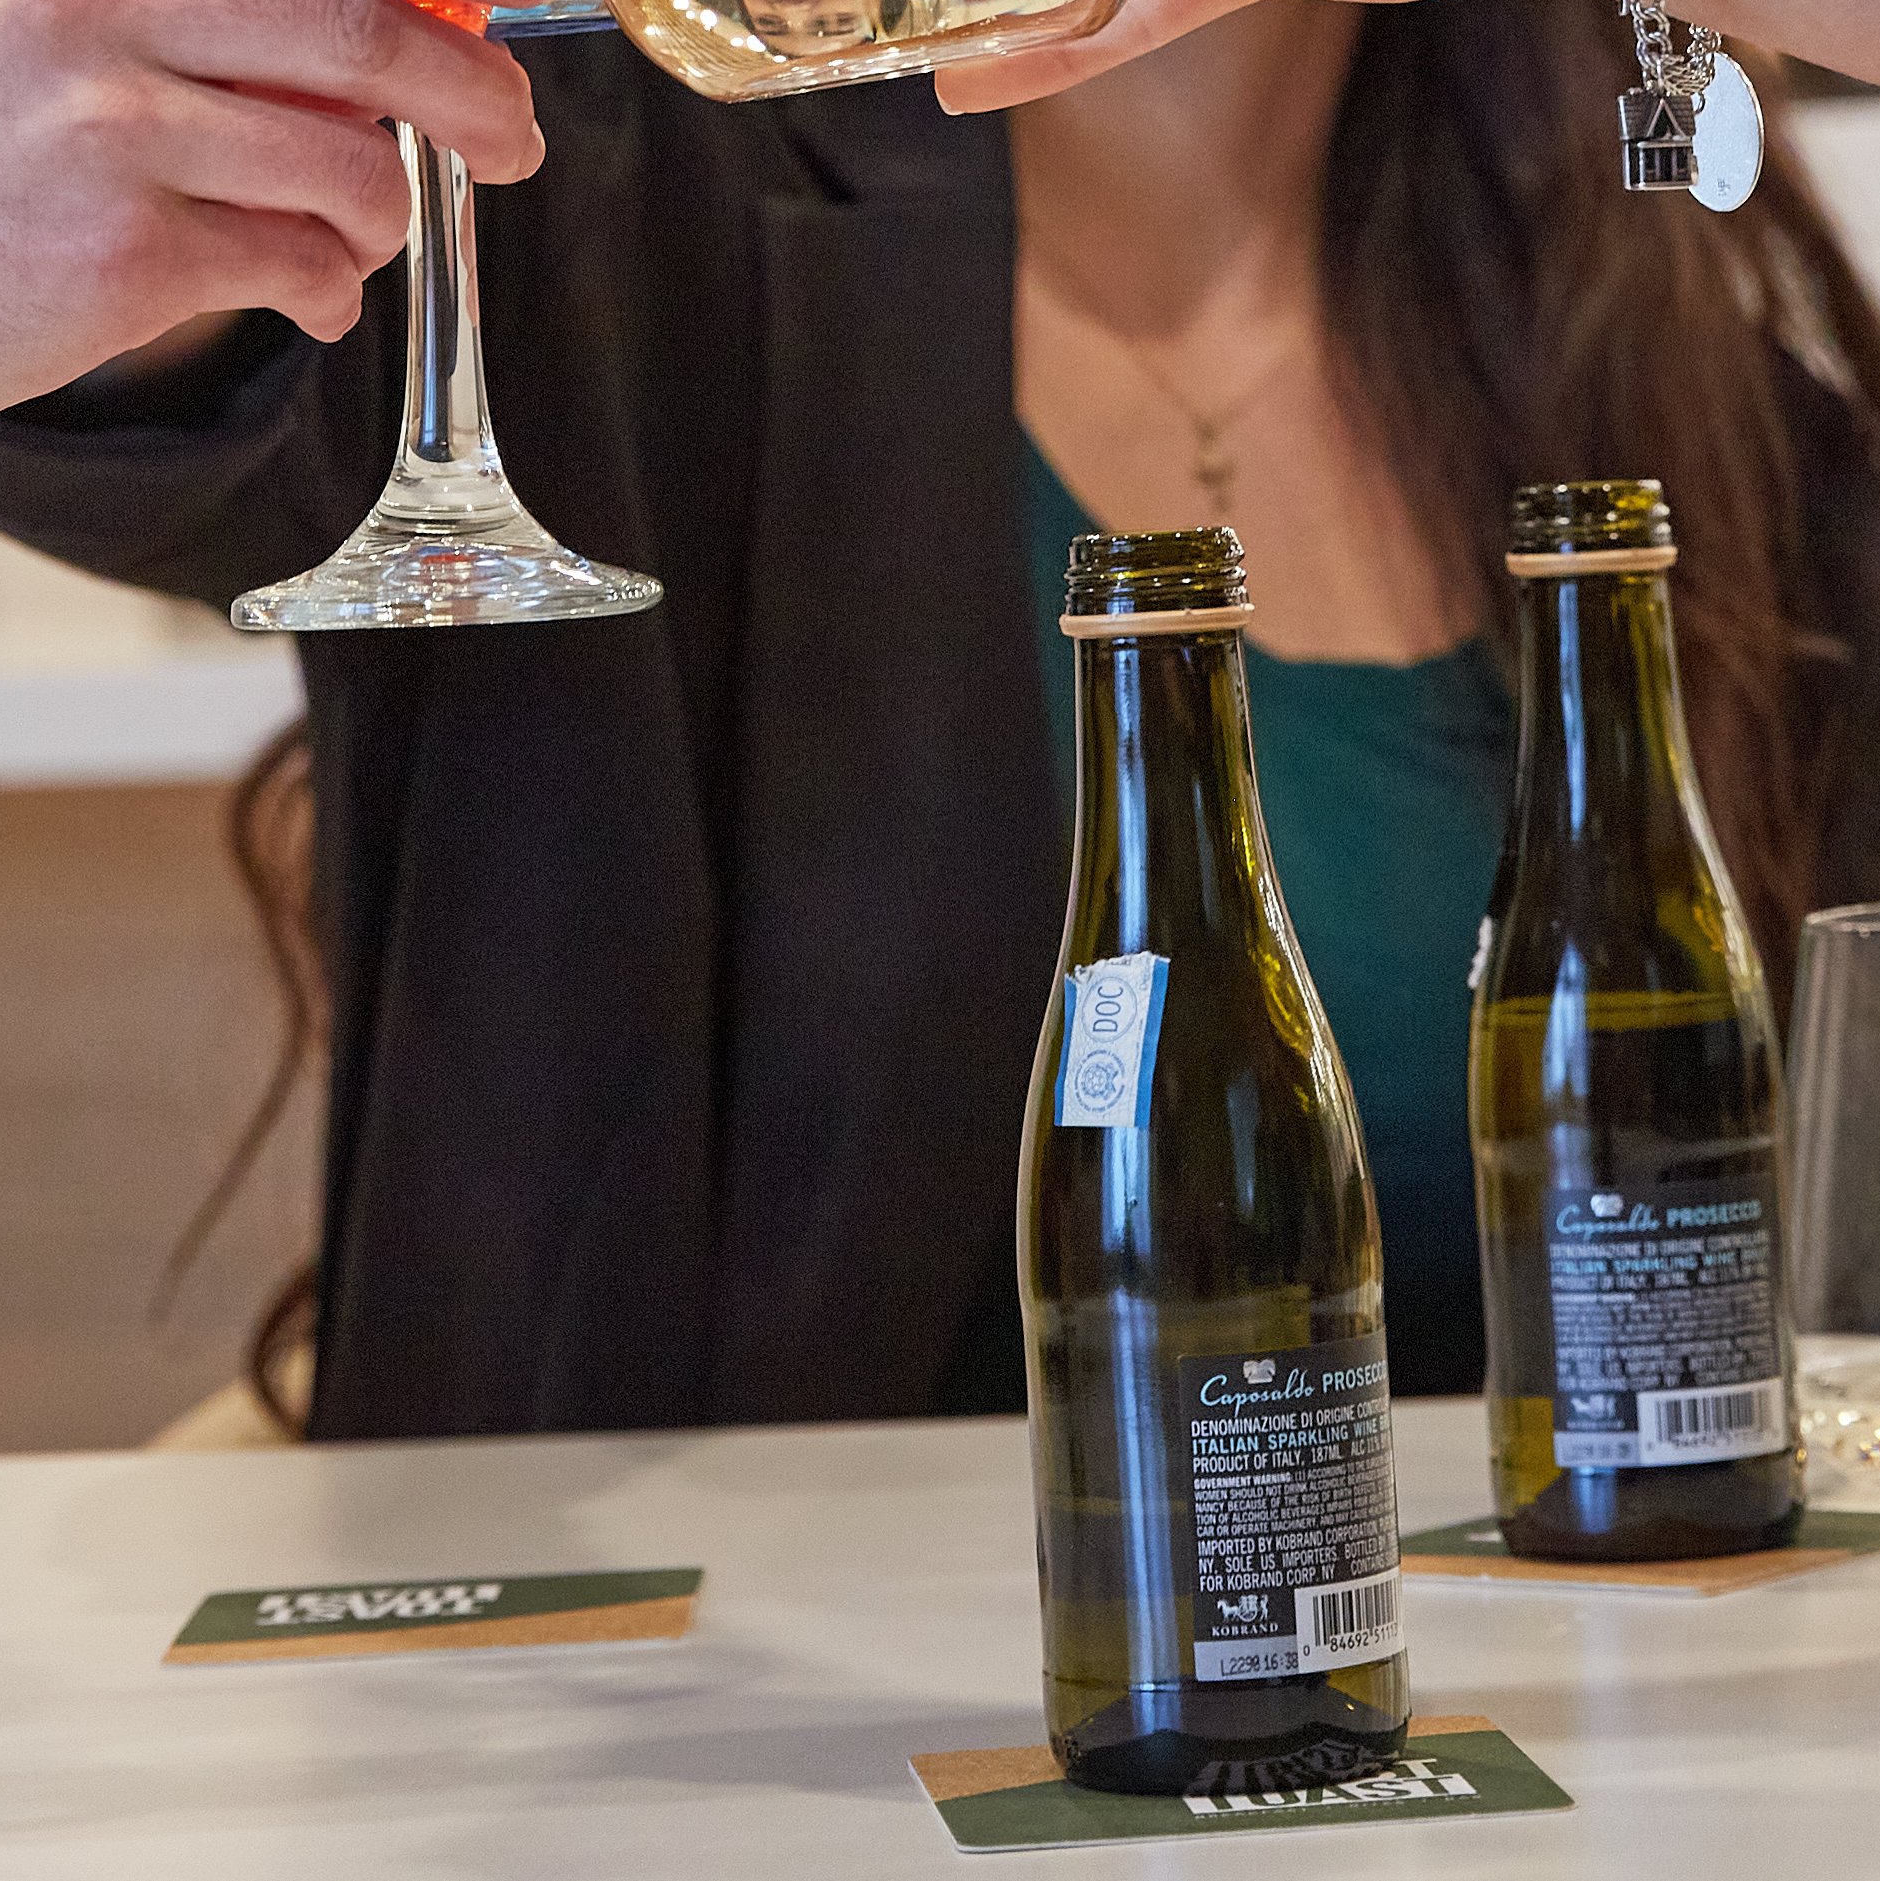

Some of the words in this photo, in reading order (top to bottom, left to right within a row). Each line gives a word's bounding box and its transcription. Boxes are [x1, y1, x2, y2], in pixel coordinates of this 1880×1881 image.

[1093, 985, 1124, 1033] DOC
[1200, 1368, 1315, 1417] Caposaldo
[1191, 1414, 1297, 1437] DENOMINAZIONE
[1301, 1413, 1313, 1429] DI
[1316, 1404, 1355, 1426] ORIGINE
[1192, 1436, 1259, 1455] ITALIAN
[1268, 1425, 1348, 1450] SPARKLING
[1193, 1455, 1251, 1473] PRODUCT
[1254, 1453, 1268, 1470] OF
[1194, 1476, 1251, 1489] GOVERNMENT
[1194, 1489, 1228, 1501] WOMEN
[1229, 1487, 1264, 1499] SHOULD
[1266, 1485, 1282, 1497] NOT
[1195, 1502, 1224, 1513] NANCY
[1228, 1499, 1267, 1512] BECAUSE
[1270, 1497, 1281, 1508] OF
[1196, 1514, 1216, 1525] TION
[1219, 1513, 1230, 1524] OF
[1232, 1509, 1279, 1523] ALCOHOLIC
[1197, 1525, 1215, 1537] CAR
[1217, 1525, 1229, 1536] OR
[1231, 1522, 1269, 1536] OPERATE
[1198, 1539, 1255, 1556] IMPORTED
[1258, 1537, 1271, 1554] BY
[1275, 1530, 1323, 1549] KOBRAND
[1225, 1555, 1253, 1573] SOLE
[1261, 1554, 1275, 1570] US
[1200, 1574, 1223, 1593] FOR
[1227, 1570, 1283, 1590] KOBRAND
[1321, 1564, 1335, 1580] NY
[1211, 1622, 1279, 1637] KOBRAND
[1303, 1645, 1311, 1657] 0
[1330, 1631, 1369, 1653] 84692
